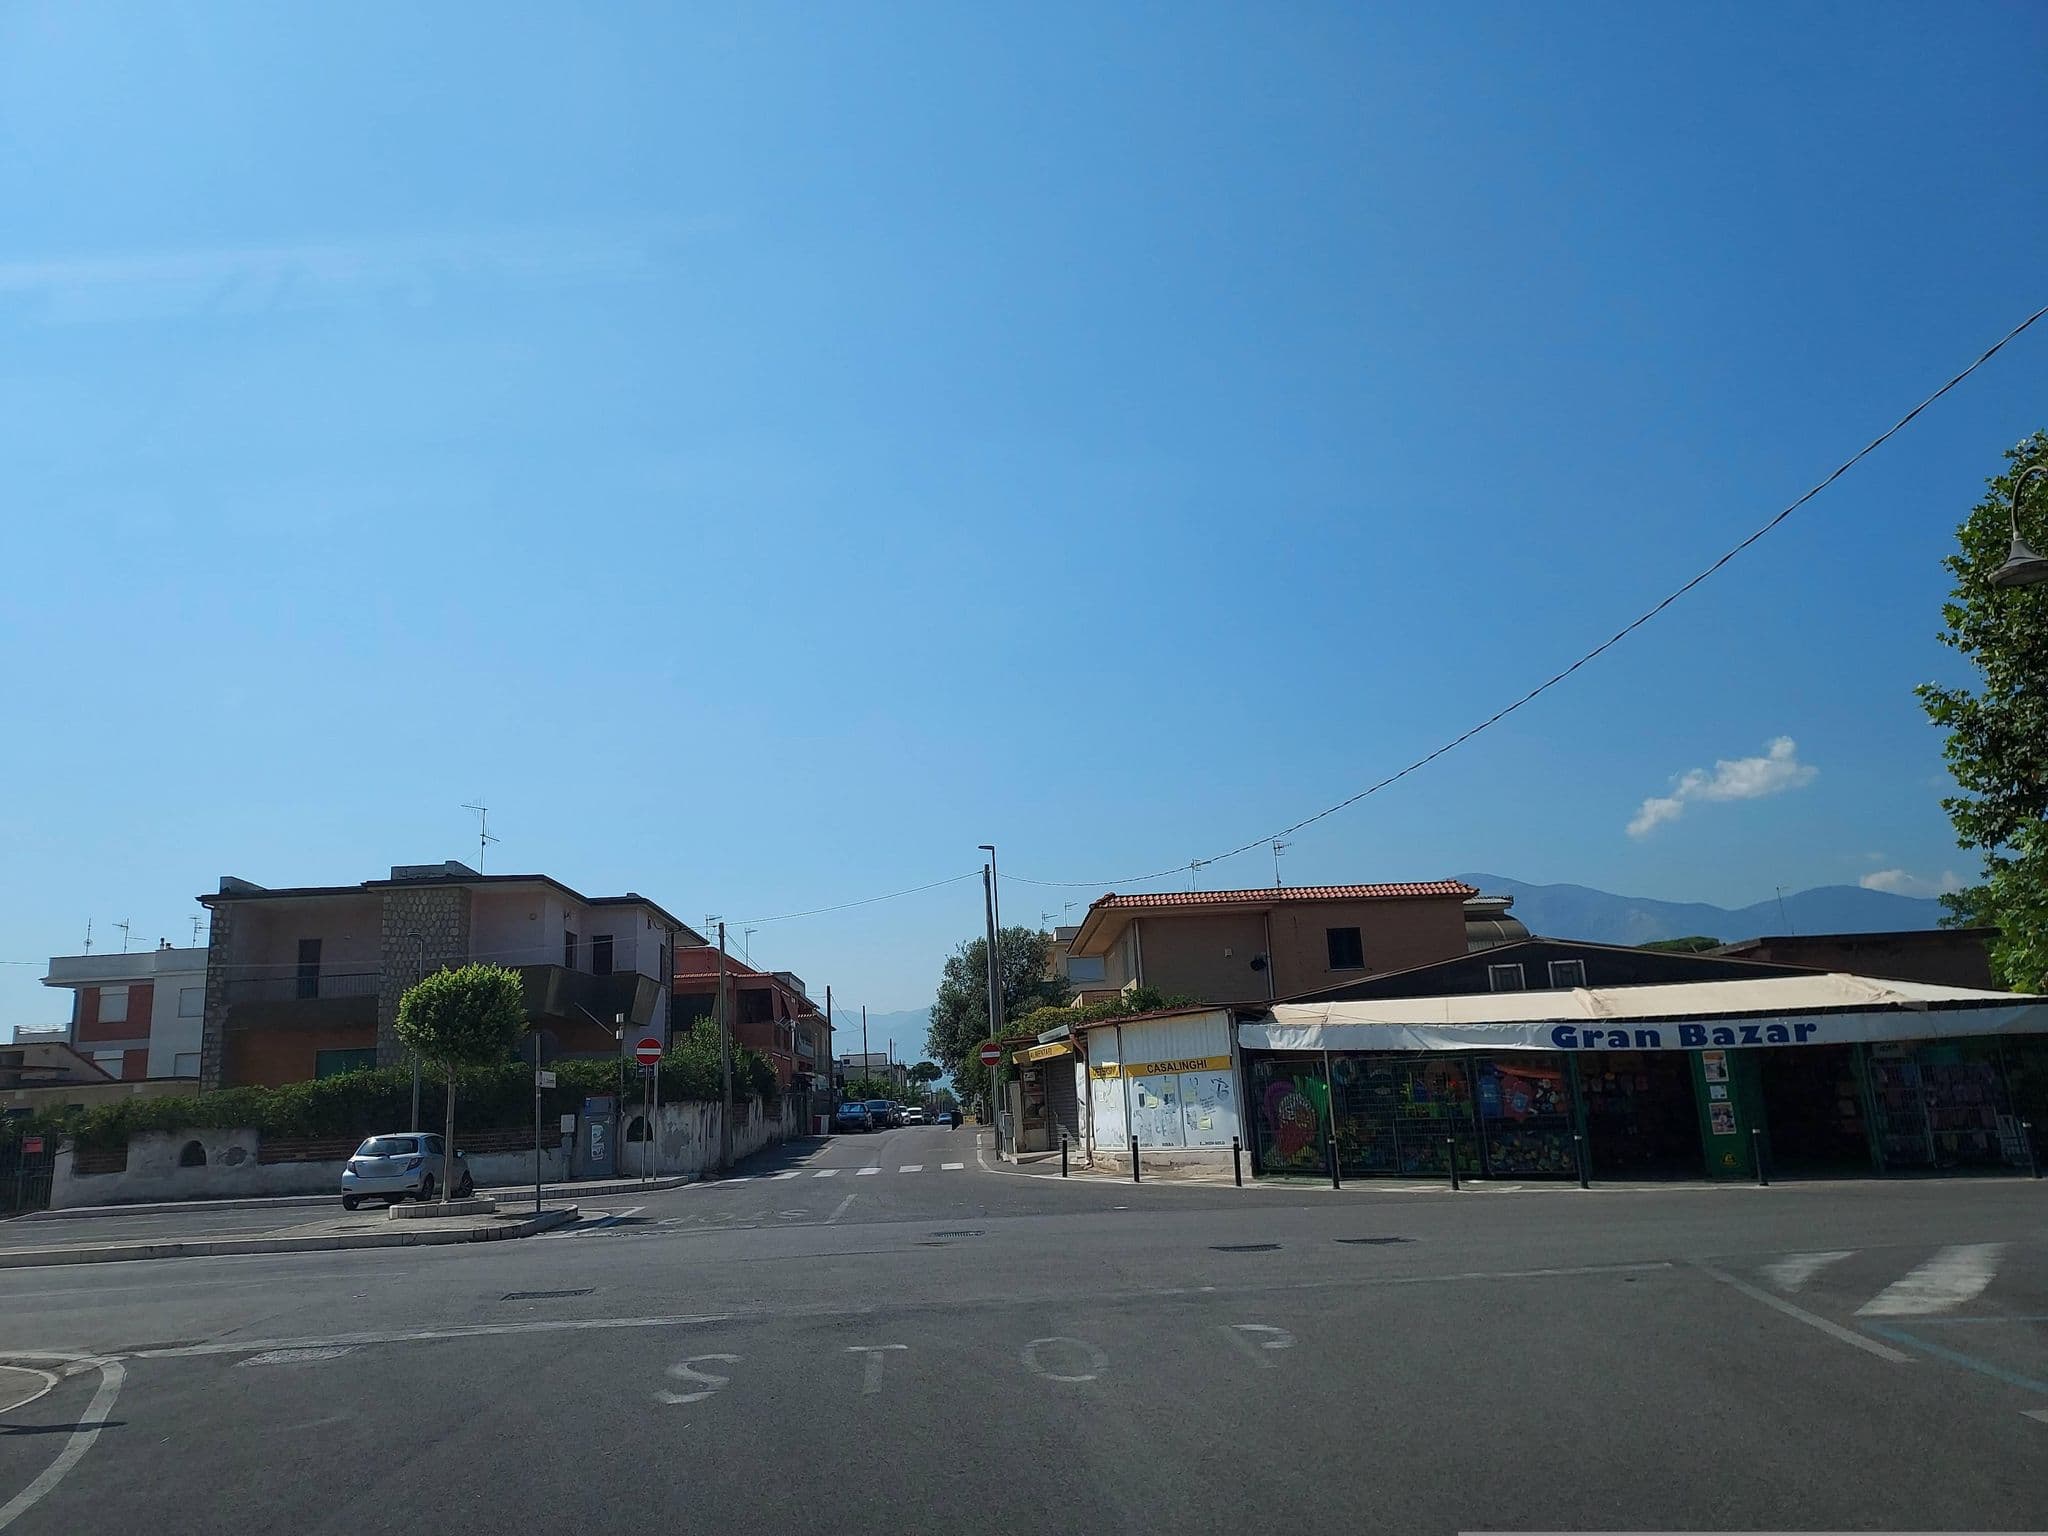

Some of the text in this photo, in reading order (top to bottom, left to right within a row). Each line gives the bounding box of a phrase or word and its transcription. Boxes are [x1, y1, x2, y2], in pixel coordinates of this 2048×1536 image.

[1551, 1022, 1817, 1049] Gran Bazar
[1146, 1059, 1207, 1073] CASALINGHI
[650, 1323, 1295, 1404] STOP
